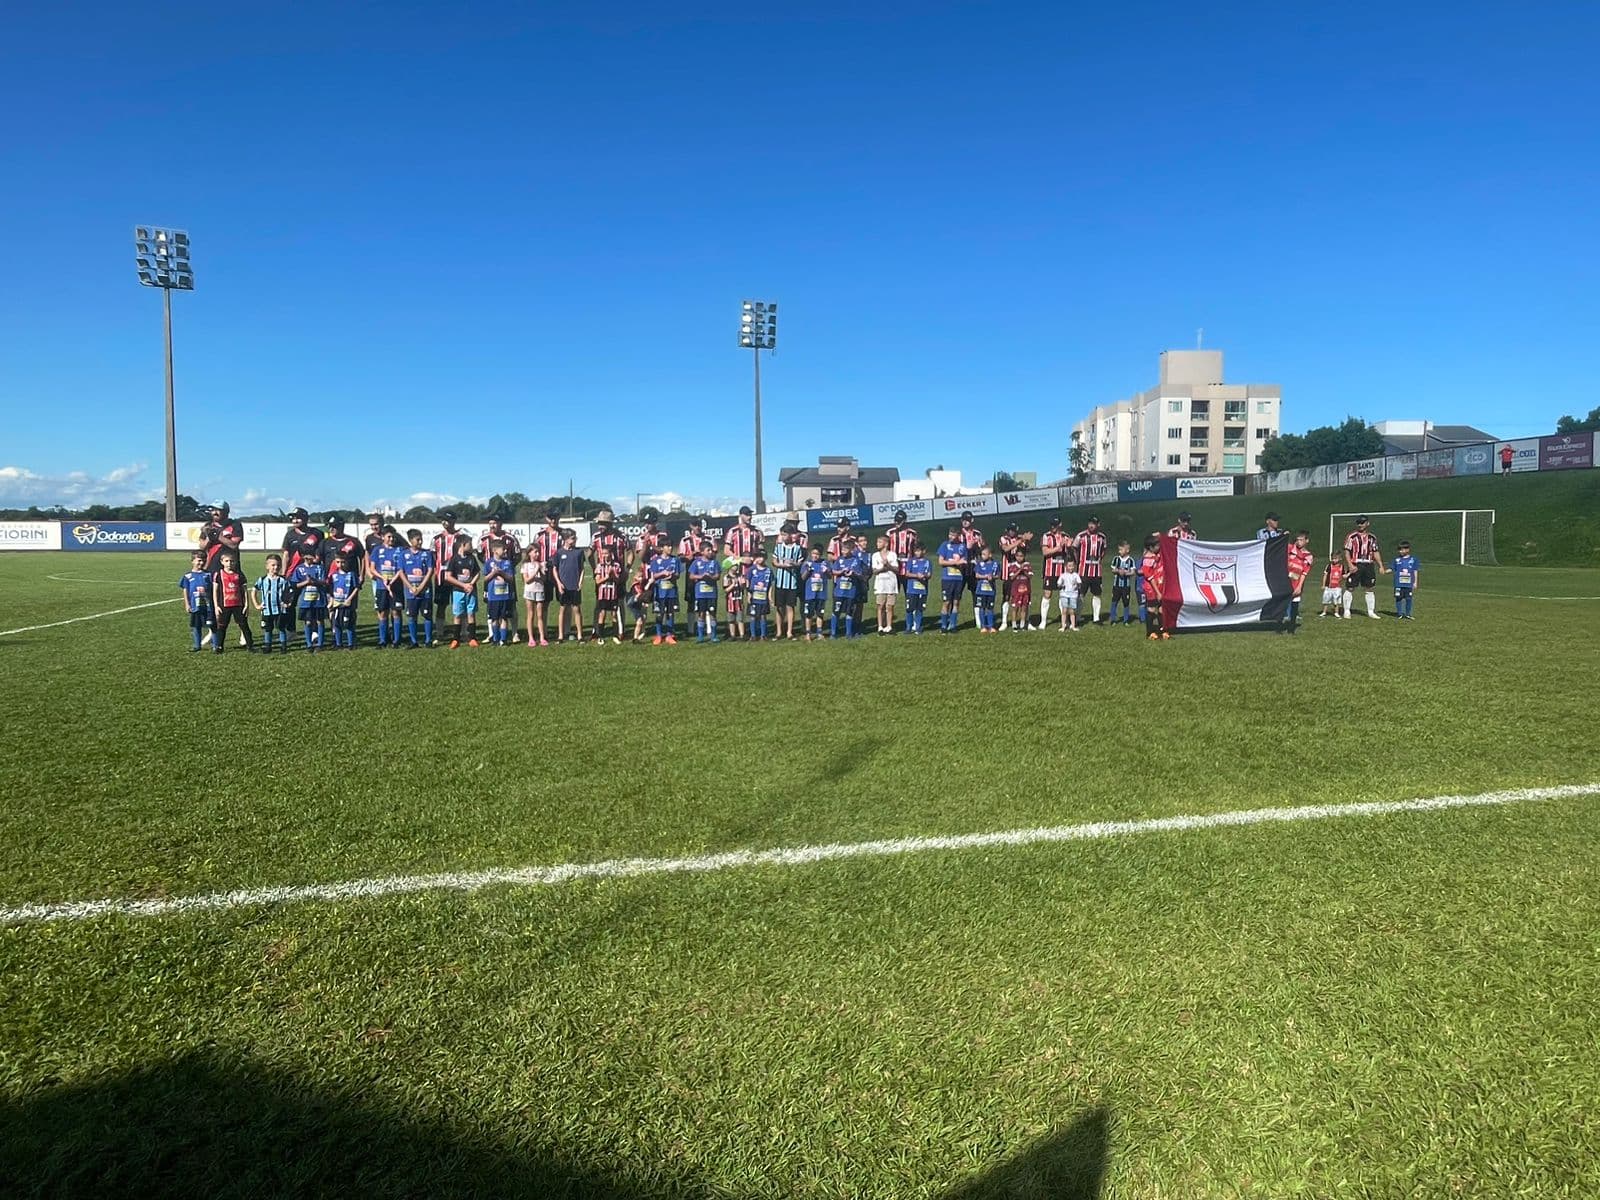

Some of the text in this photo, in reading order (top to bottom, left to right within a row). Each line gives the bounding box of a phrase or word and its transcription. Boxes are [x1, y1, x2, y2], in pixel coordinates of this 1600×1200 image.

[1128, 481, 1152, 491] JUMP
[957, 500, 986, 509] ECKERT
[1204, 572, 1226, 582] AJAP
